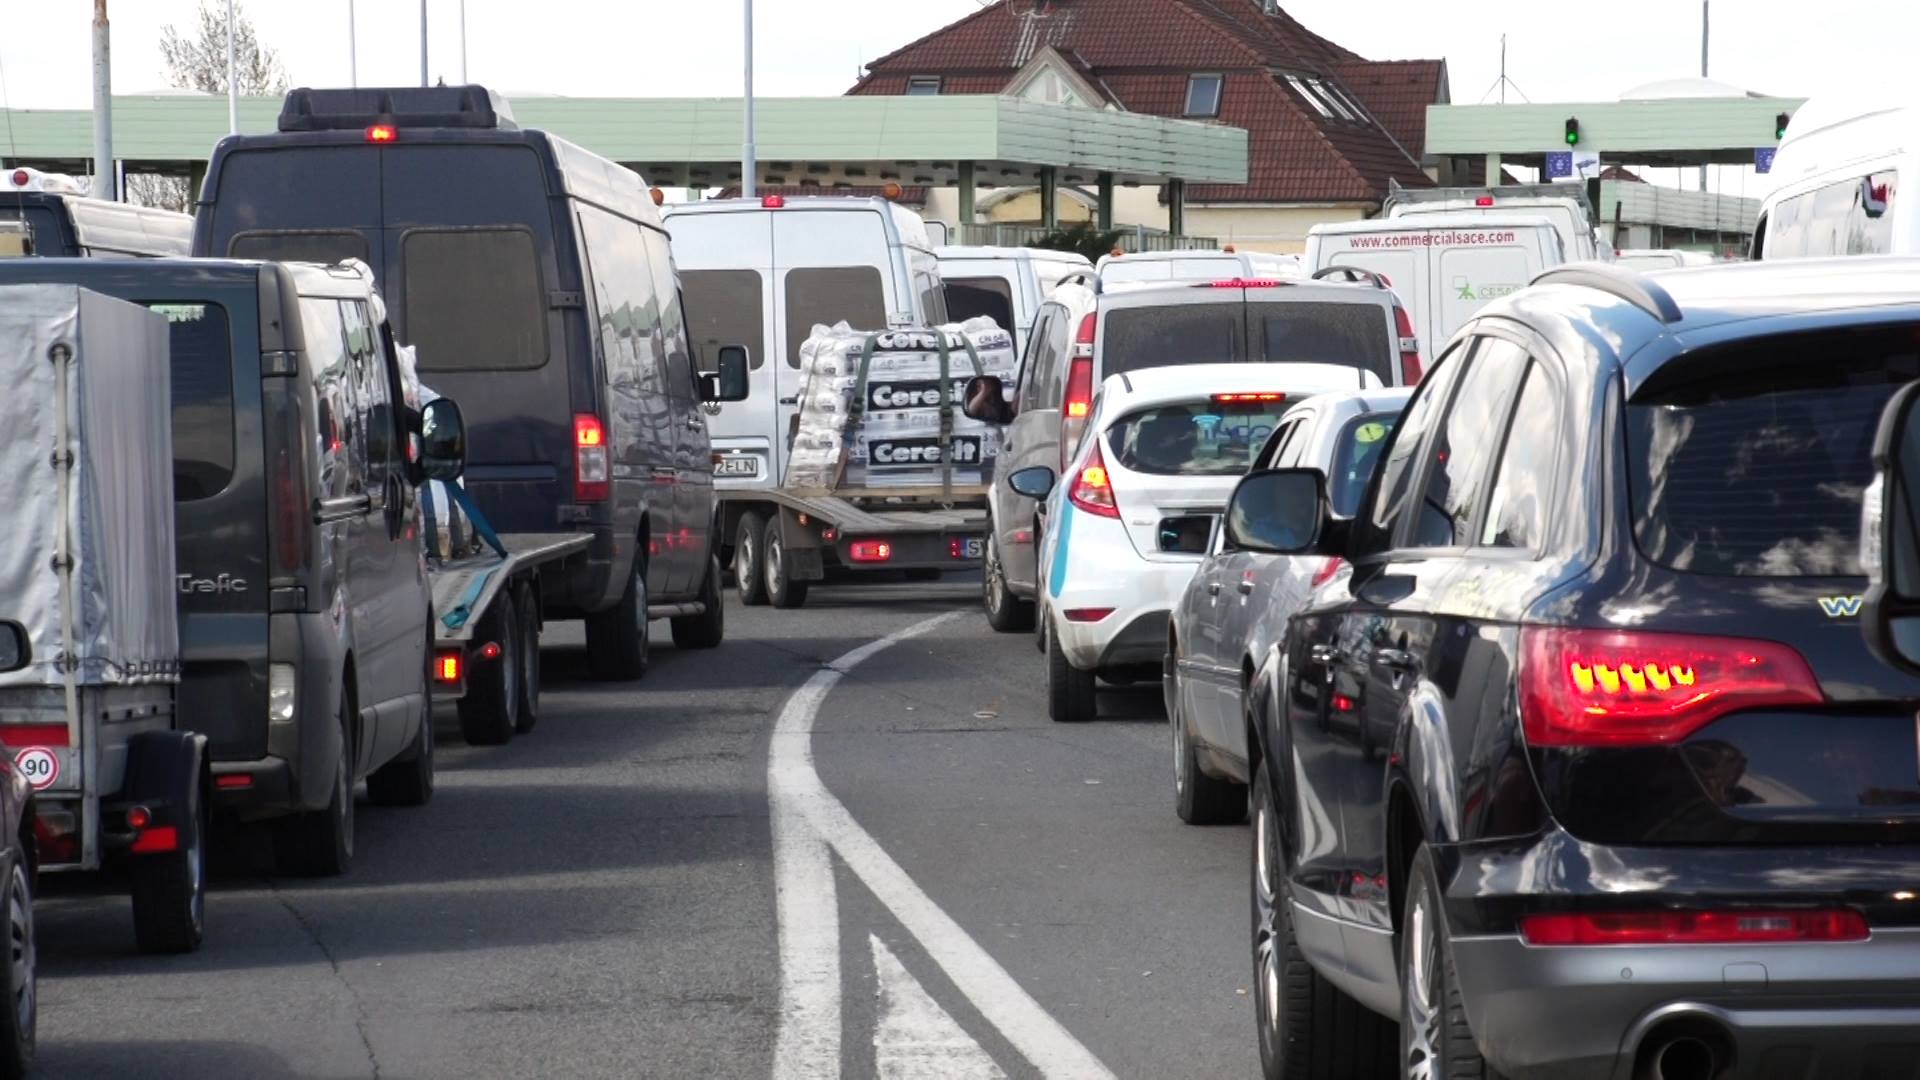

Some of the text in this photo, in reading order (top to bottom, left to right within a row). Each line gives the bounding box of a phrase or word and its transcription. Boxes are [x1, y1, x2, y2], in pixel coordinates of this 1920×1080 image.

[1350, 231, 1515, 248] www.commercialsace.com
[876, 332, 964, 349] Cereit
[872, 380, 968, 408] Cerei
[874, 439, 976, 463] Cereit
[176, 572, 249, 594] Trafic
[26, 759, 49, 776] 90
